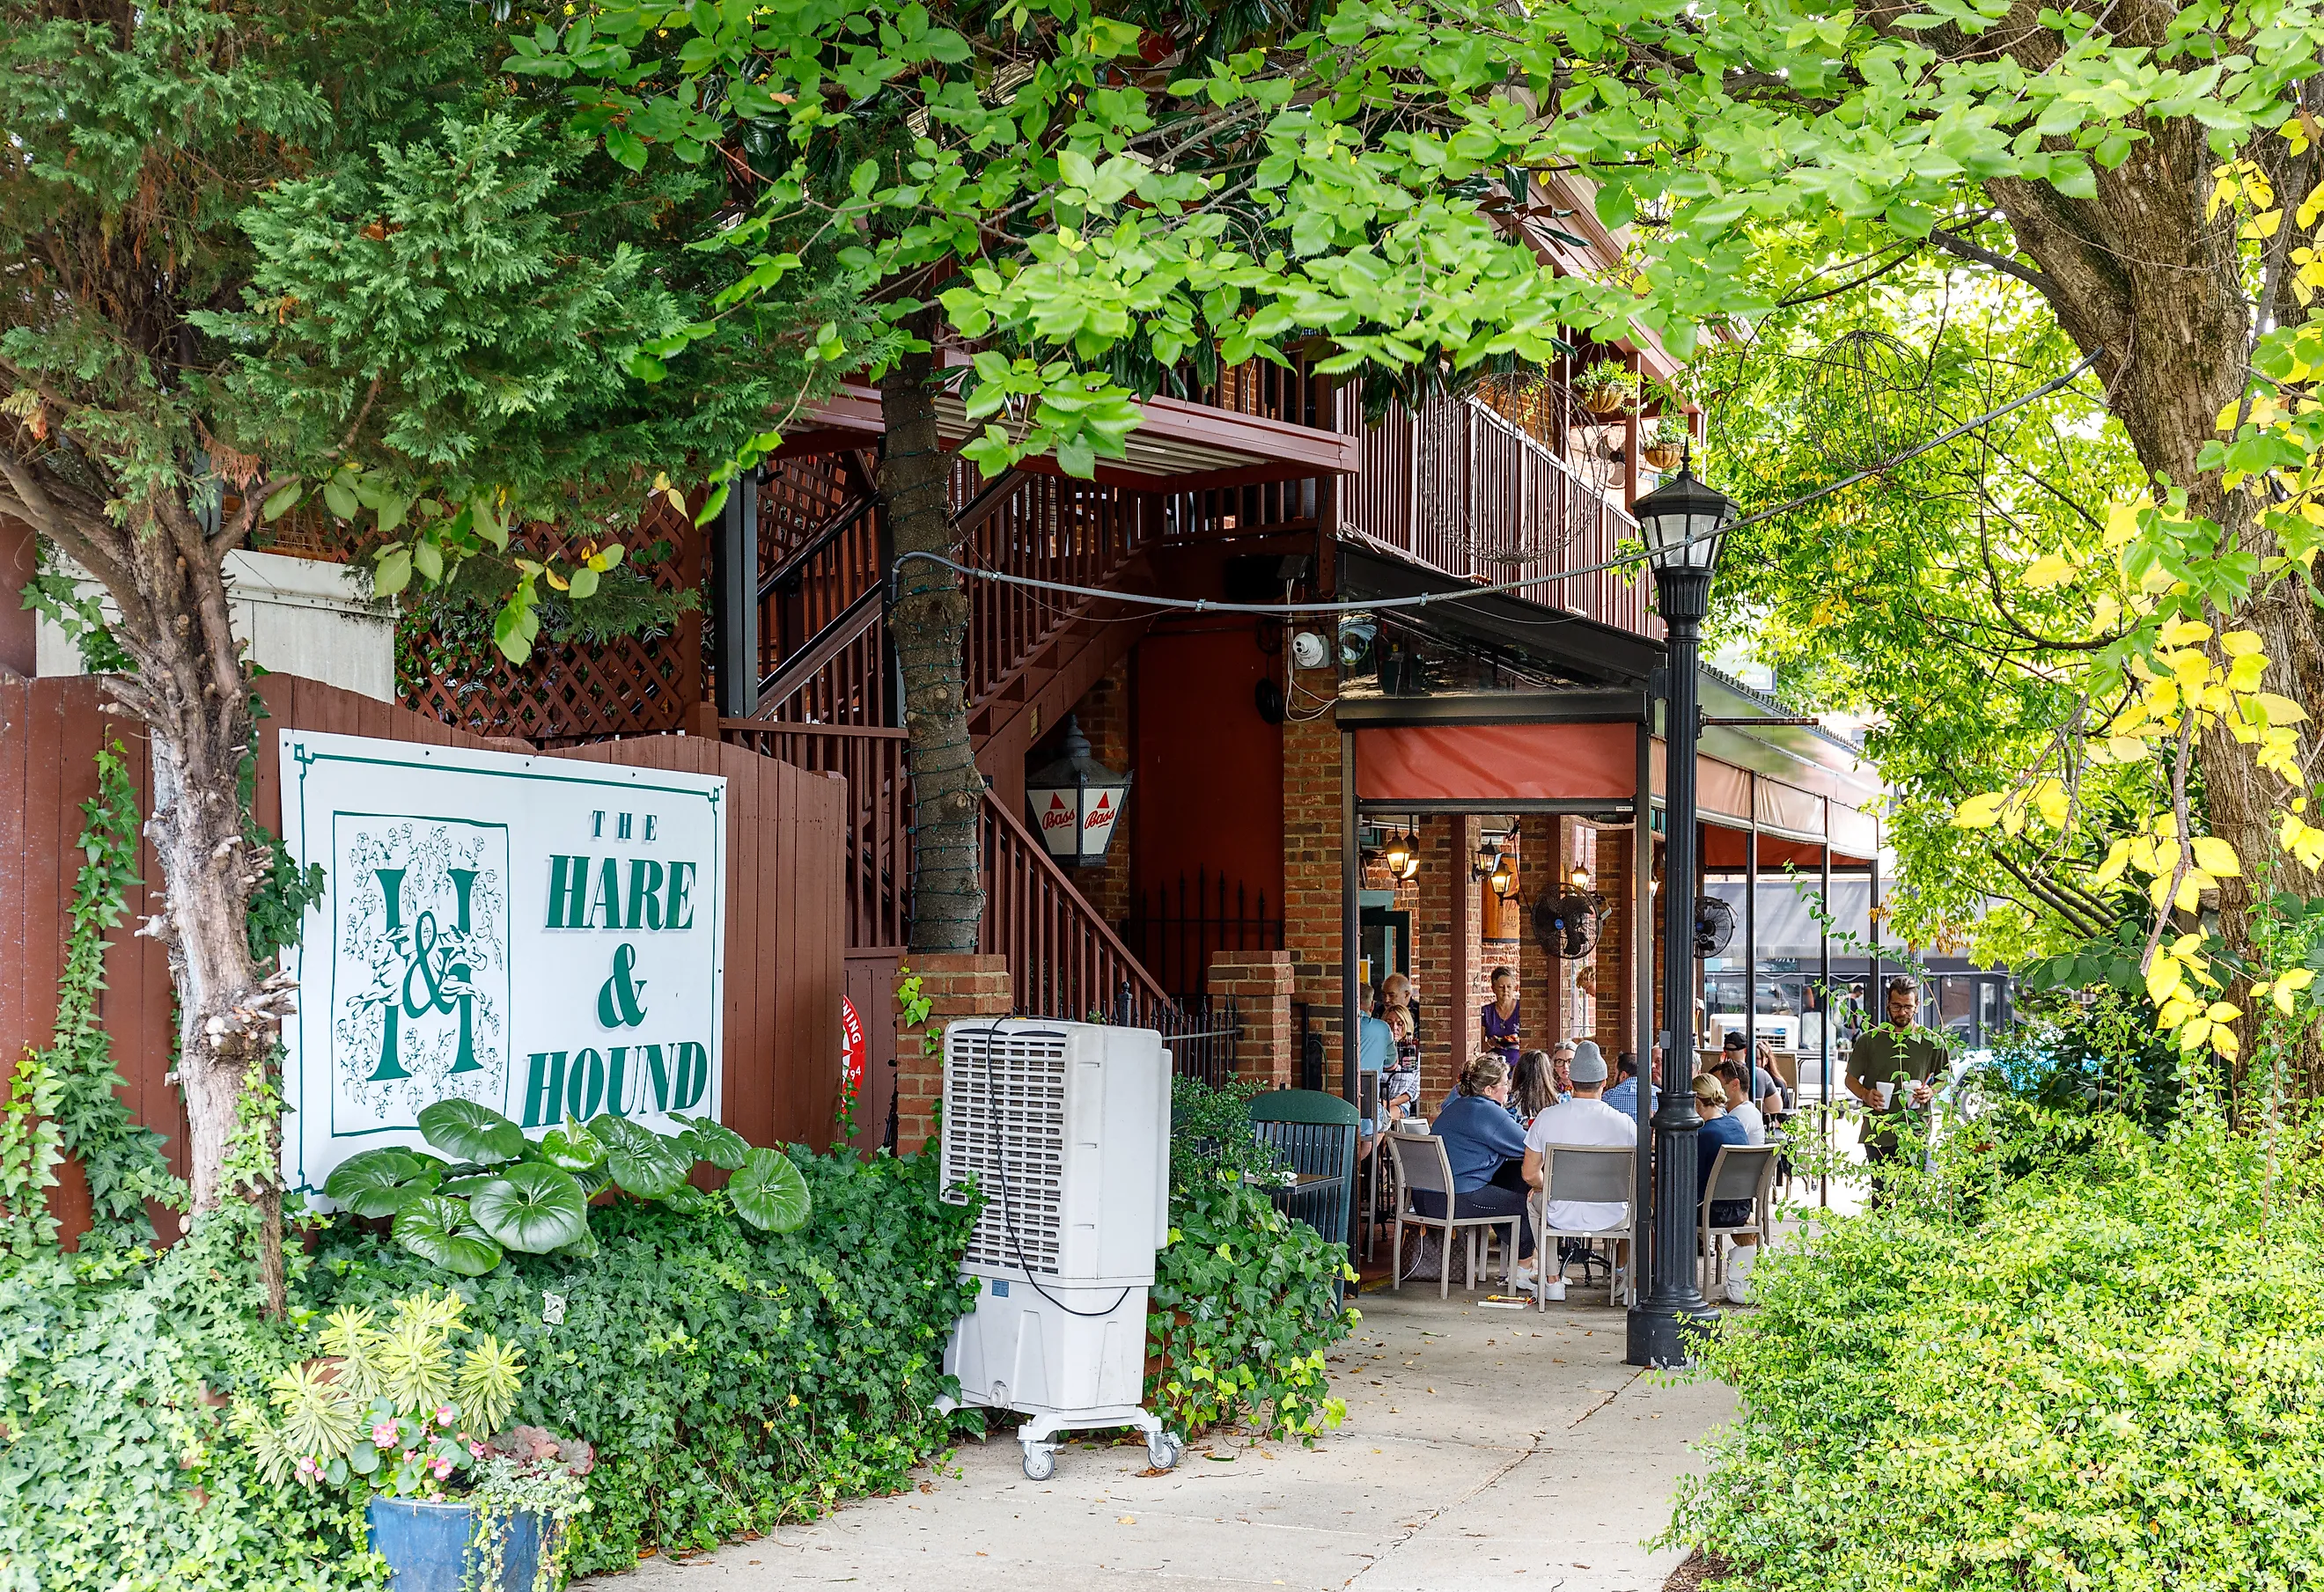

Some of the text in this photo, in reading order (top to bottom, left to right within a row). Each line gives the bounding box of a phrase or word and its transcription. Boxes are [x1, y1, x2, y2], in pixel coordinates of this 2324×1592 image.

[592, 810, 658, 840] THE
[1042, 809, 1076, 830] Bass
[1085, 808, 1115, 829] Bass
[545, 855, 696, 931] HARE
[597, 943, 649, 1029] &
[520, 1042, 707, 1129] HOUND
